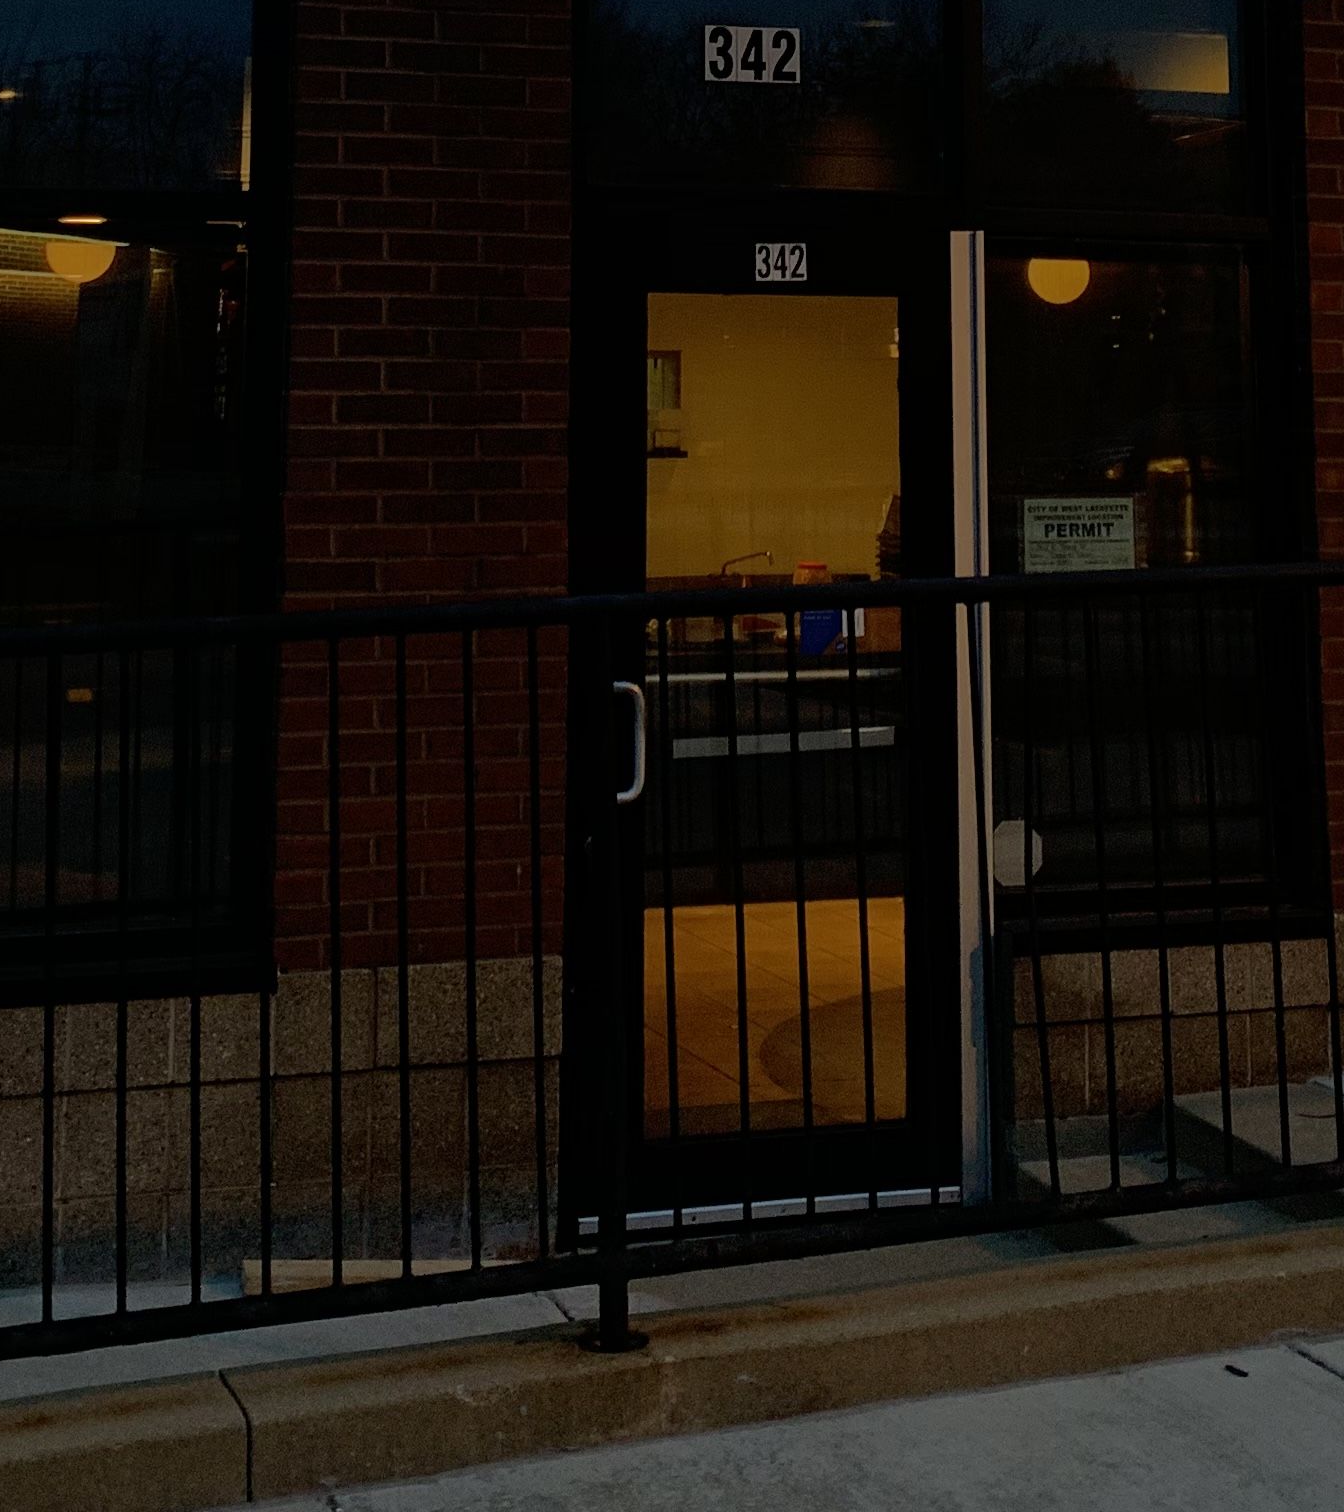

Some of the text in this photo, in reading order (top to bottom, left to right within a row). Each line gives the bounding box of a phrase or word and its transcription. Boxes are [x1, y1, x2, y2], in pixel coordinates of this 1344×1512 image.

[709, 26, 798, 82] 342
[757, 244, 805, 279] 342
[1044, 522, 1115, 538] PERMIT
